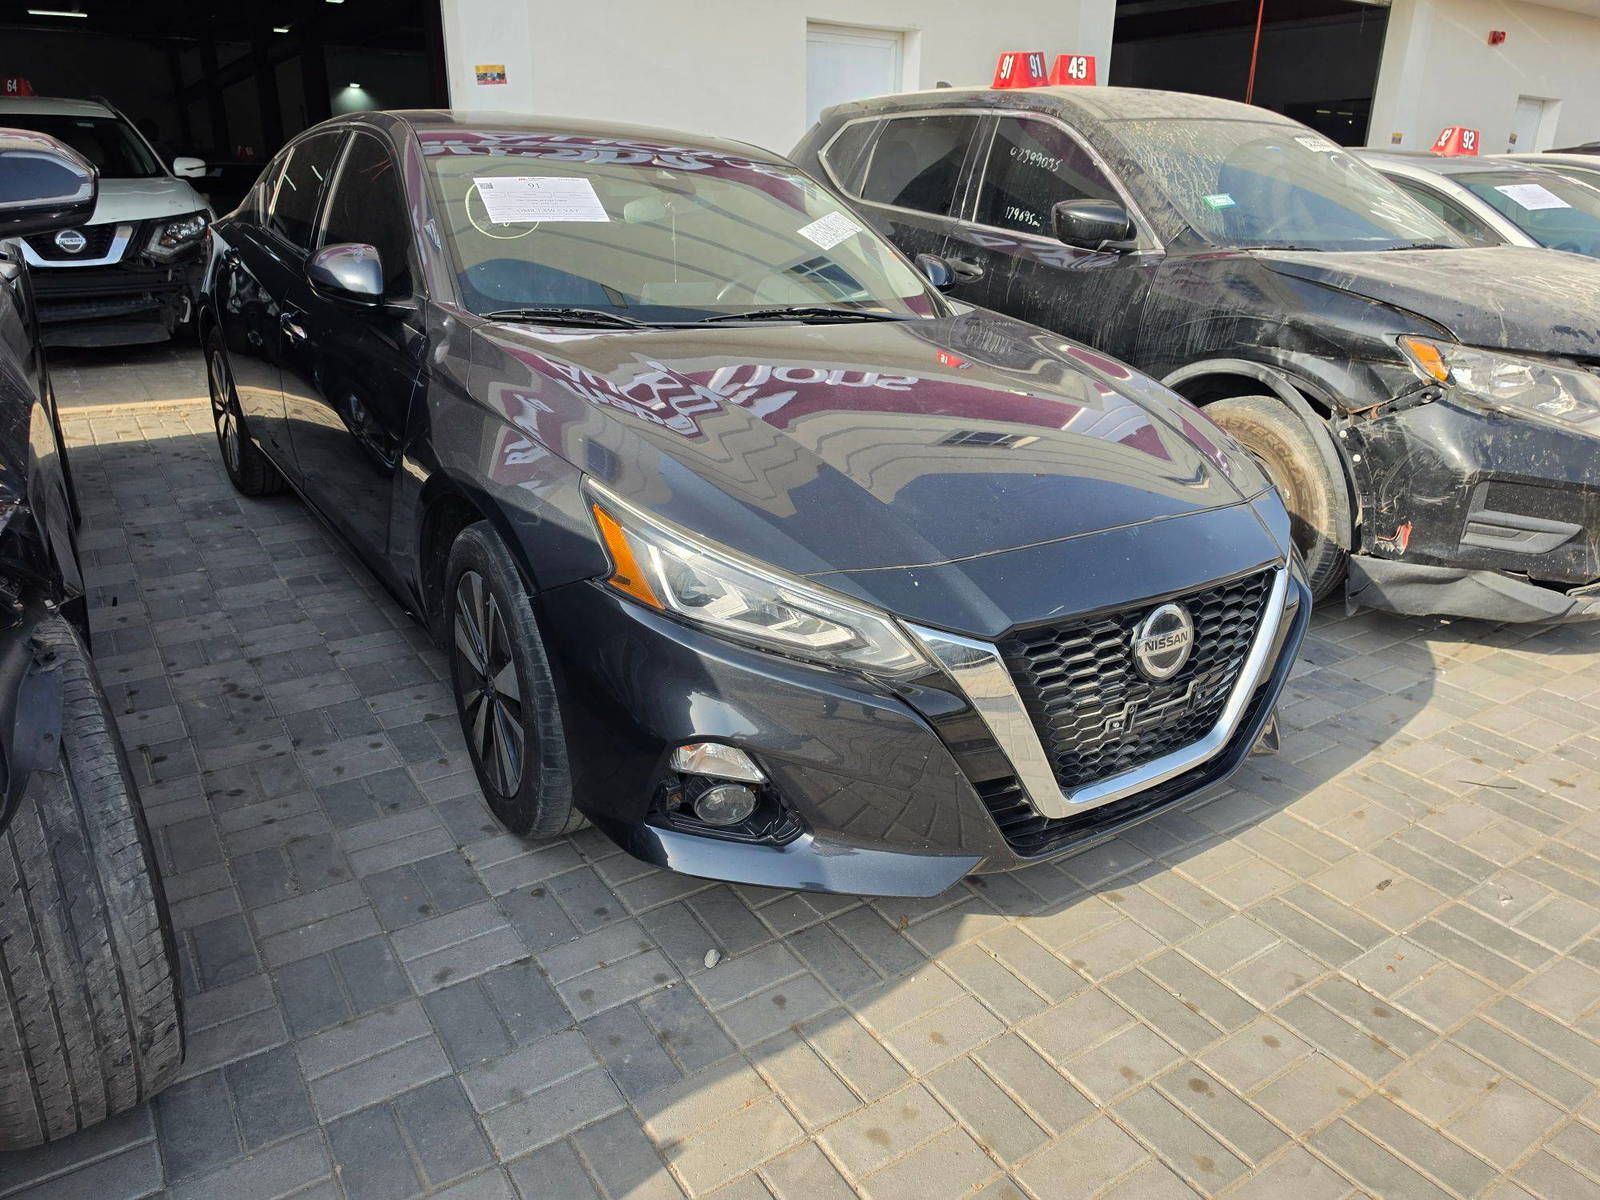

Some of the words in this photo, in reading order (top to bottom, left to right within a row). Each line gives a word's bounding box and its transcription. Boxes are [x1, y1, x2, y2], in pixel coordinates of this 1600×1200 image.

[1000, 55, 1014, 79] 91
[1029, 54, 1042, 78] 91
[1067, 56, 1087, 79] 43
[7, 79, 17, 92] 64
[1462, 130, 1475, 150] 92
[1144, 631, 1188, 653] NISSAN
